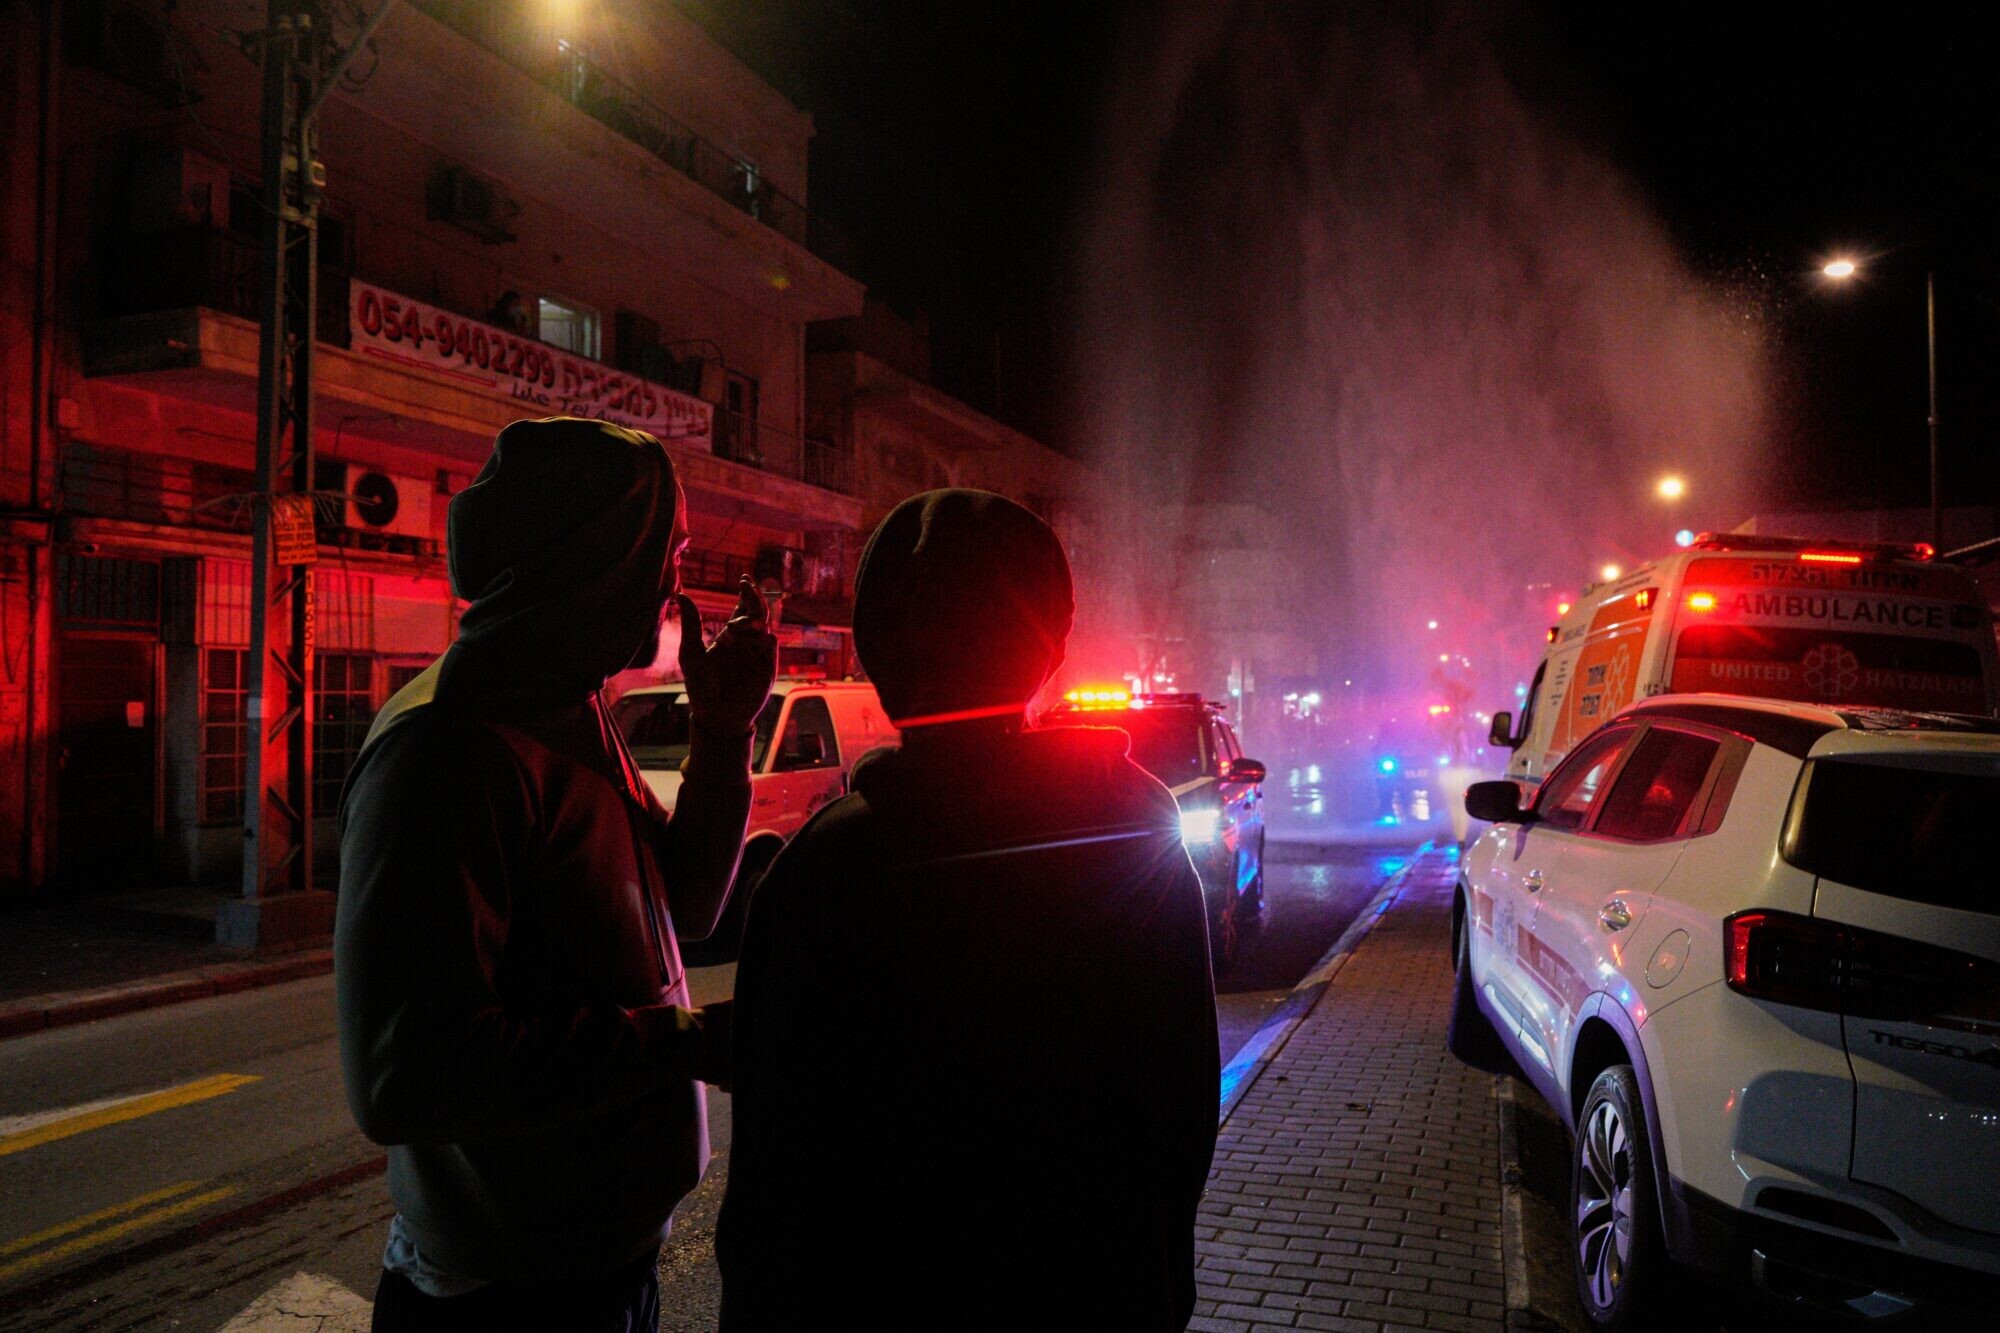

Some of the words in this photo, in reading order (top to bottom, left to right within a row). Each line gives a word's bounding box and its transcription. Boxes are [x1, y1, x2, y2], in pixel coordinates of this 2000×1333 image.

[358, 289, 555, 388] 054-9402299
[556, 397, 589, 417] Tel
[1752, 563, 1827, 582] הצלה
[1732, 592, 1945, 629] AMBULANCE
[1710, 662, 1790, 682] UNITED
